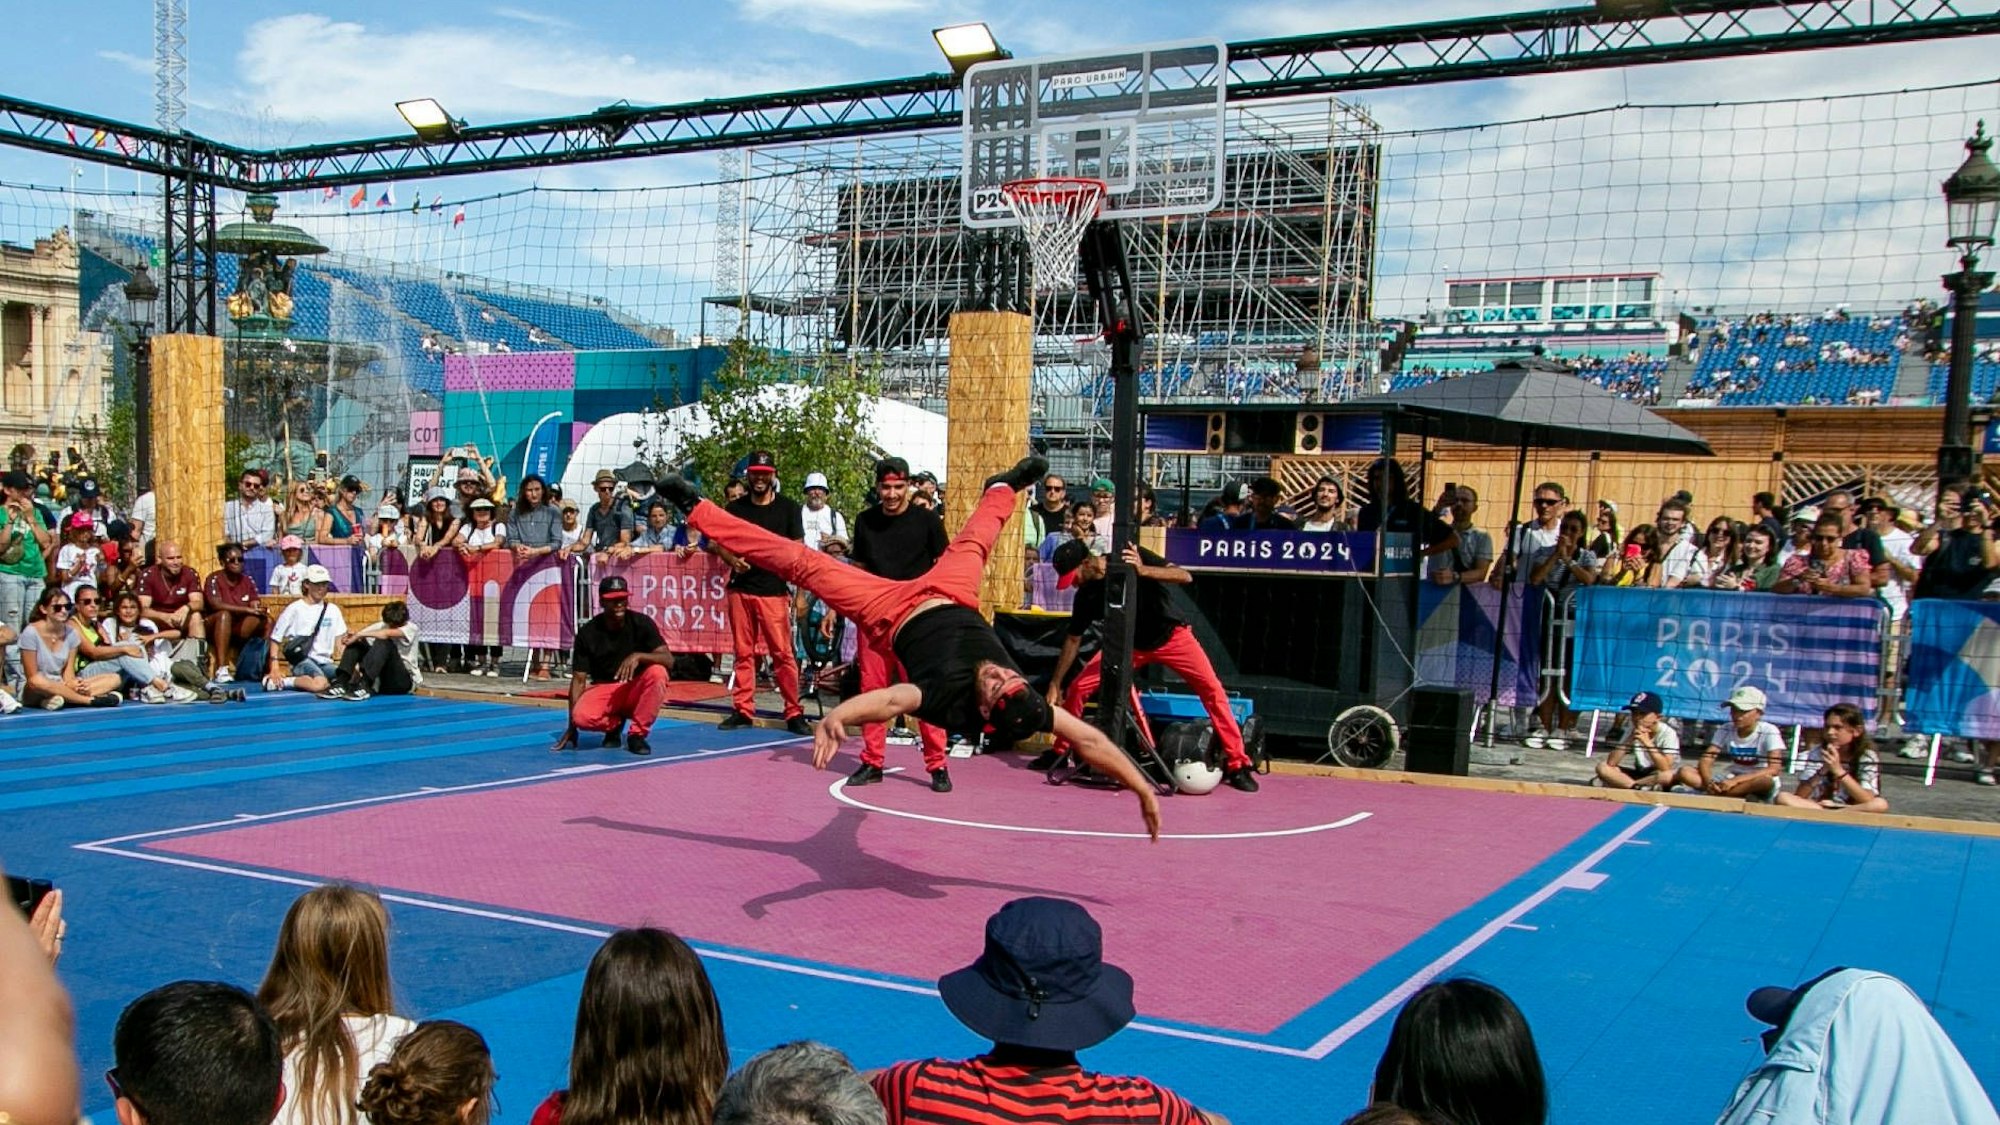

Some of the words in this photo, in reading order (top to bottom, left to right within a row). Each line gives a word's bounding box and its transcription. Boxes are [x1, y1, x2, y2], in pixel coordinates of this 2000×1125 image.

[1086, 70, 1125, 83] URBAIN
[1282, 541, 1350, 561] 2024
[1655, 655, 1787, 694] 2024
